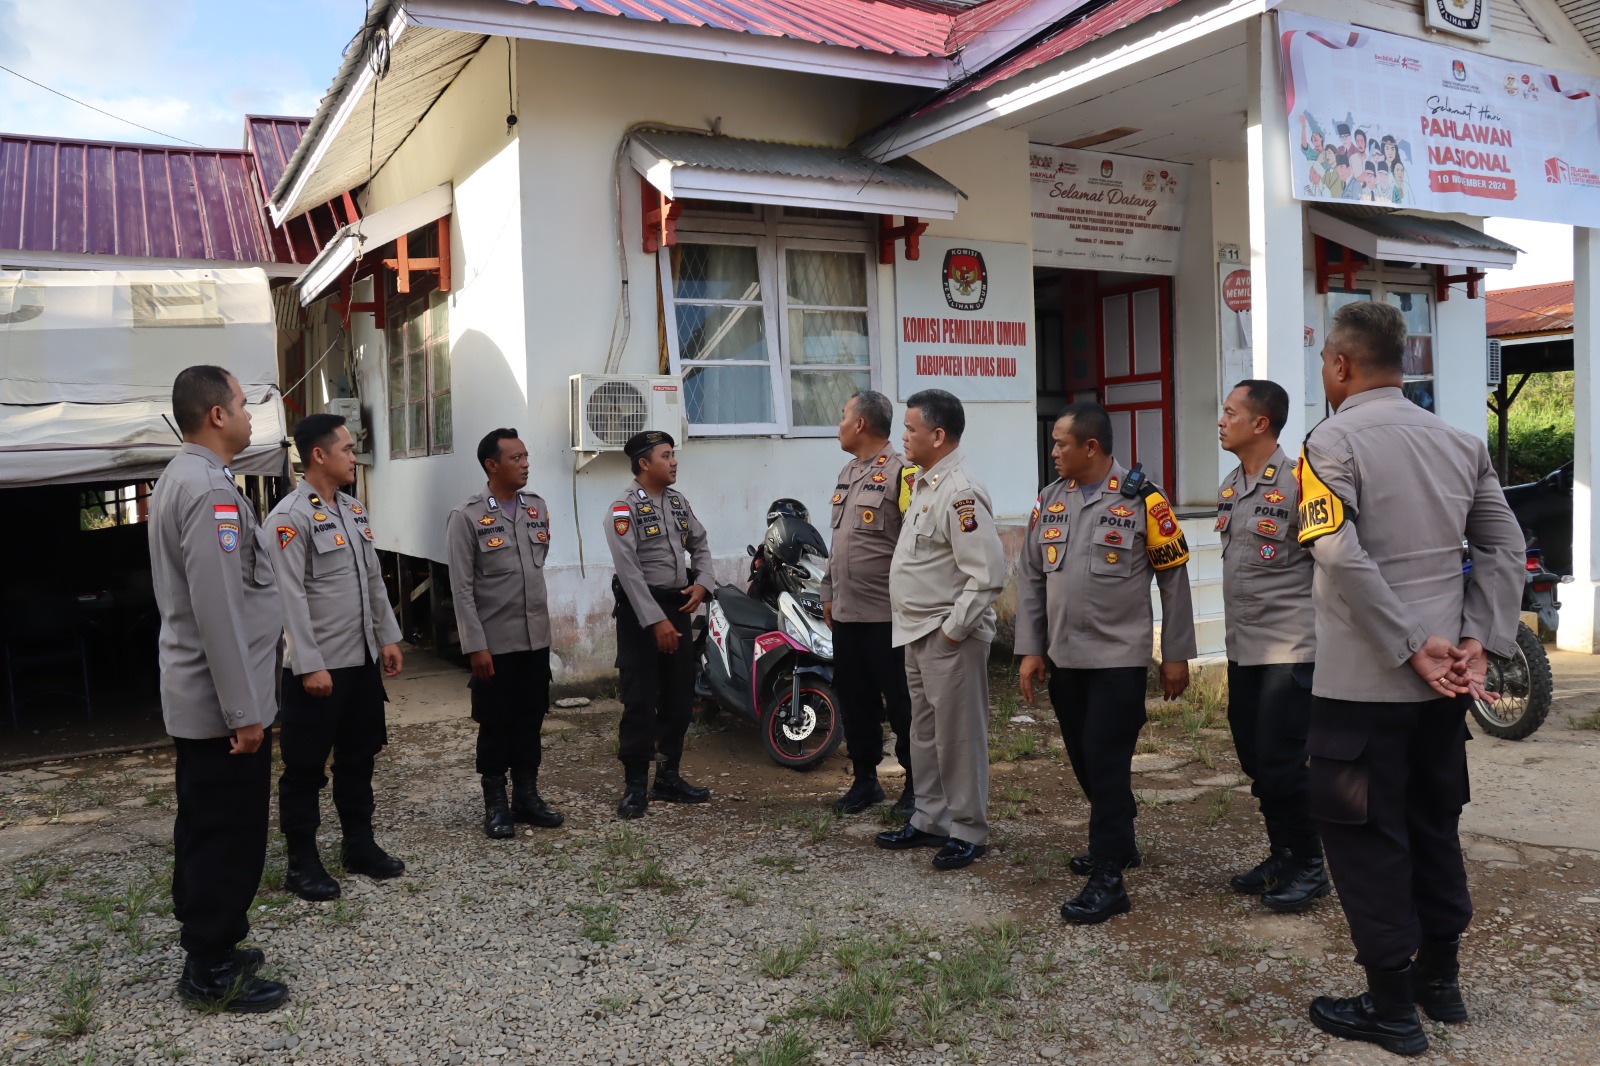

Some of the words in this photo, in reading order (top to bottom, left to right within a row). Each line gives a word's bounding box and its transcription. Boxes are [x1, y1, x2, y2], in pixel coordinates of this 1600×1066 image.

[1437, 0, 1468, 28] MILIHAN
[1426, 95, 1477, 121] Selamat
[1477, 105, 1502, 122] Hari
[1420, 115, 1513, 148] PAHLAWAN
[1427, 145, 1512, 173] NASIONAL
[1452, 174, 1487, 189] NOVEMBER
[1488, 180, 1507, 191] 2024
[1049, 181, 1104, 203] Selamat
[1107, 188, 1158, 215] Datang
[951, 249, 978, 258] KOMISI
[1228, 249, 1239, 260] 11
[1235, 277, 1251, 287] AYO
[943, 281, 975, 310] PEMILIHAN
[975, 283, 987, 309] UMUM
[1226, 287, 1251, 299] MEMIL
[903, 316, 941, 344] KOMISI
[942, 318, 995, 346] PEMILIHAN
[996, 320, 1027, 347] UMUM
[915, 354, 963, 377] KABUPATEN
[963, 355, 996, 378] KAPUAS
[996, 356, 1017, 378] HULU
[862, 483, 886, 493] POLRI
[1042, 514, 1069, 523] EDHI
[1254, 505, 1289, 520] POLRI
[313, 522, 338, 535] AGUNG
[1099, 516, 1136, 529] POLRI
[759, 636, 781, 646] 125
